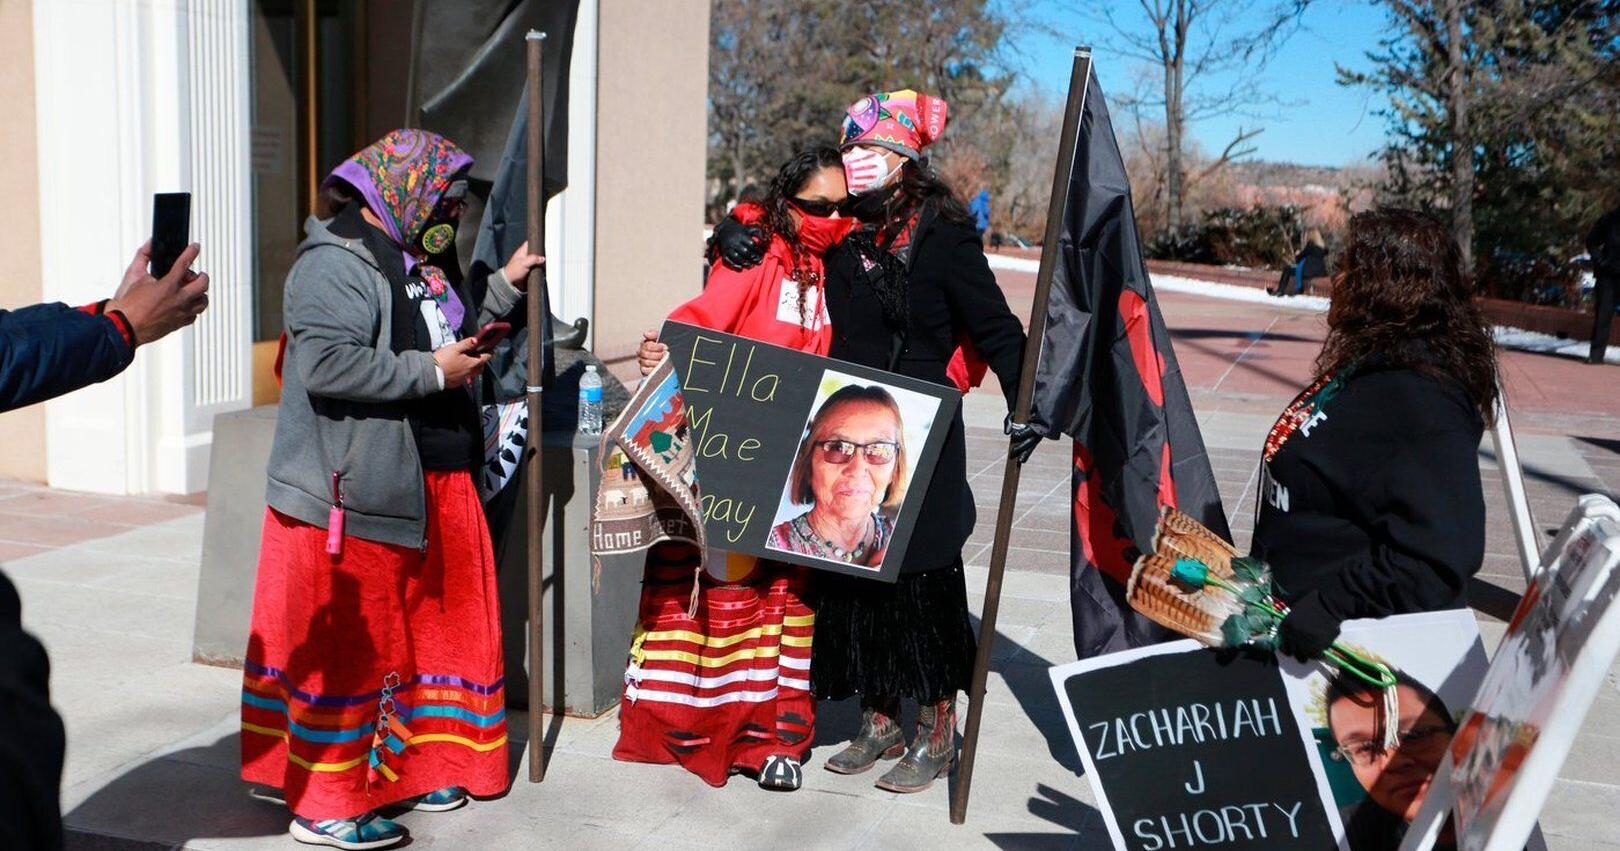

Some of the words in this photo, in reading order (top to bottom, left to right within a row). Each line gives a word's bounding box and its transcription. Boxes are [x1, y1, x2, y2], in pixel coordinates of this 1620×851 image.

[683, 335, 779, 402] Ella
[685, 405, 761, 461] Mae
[593, 521, 642, 550] Home
[1089, 698, 1282, 760] ZACHARIAH
[1184, 760, 1206, 794] J
[1133, 801, 1302, 851] SHORTY
